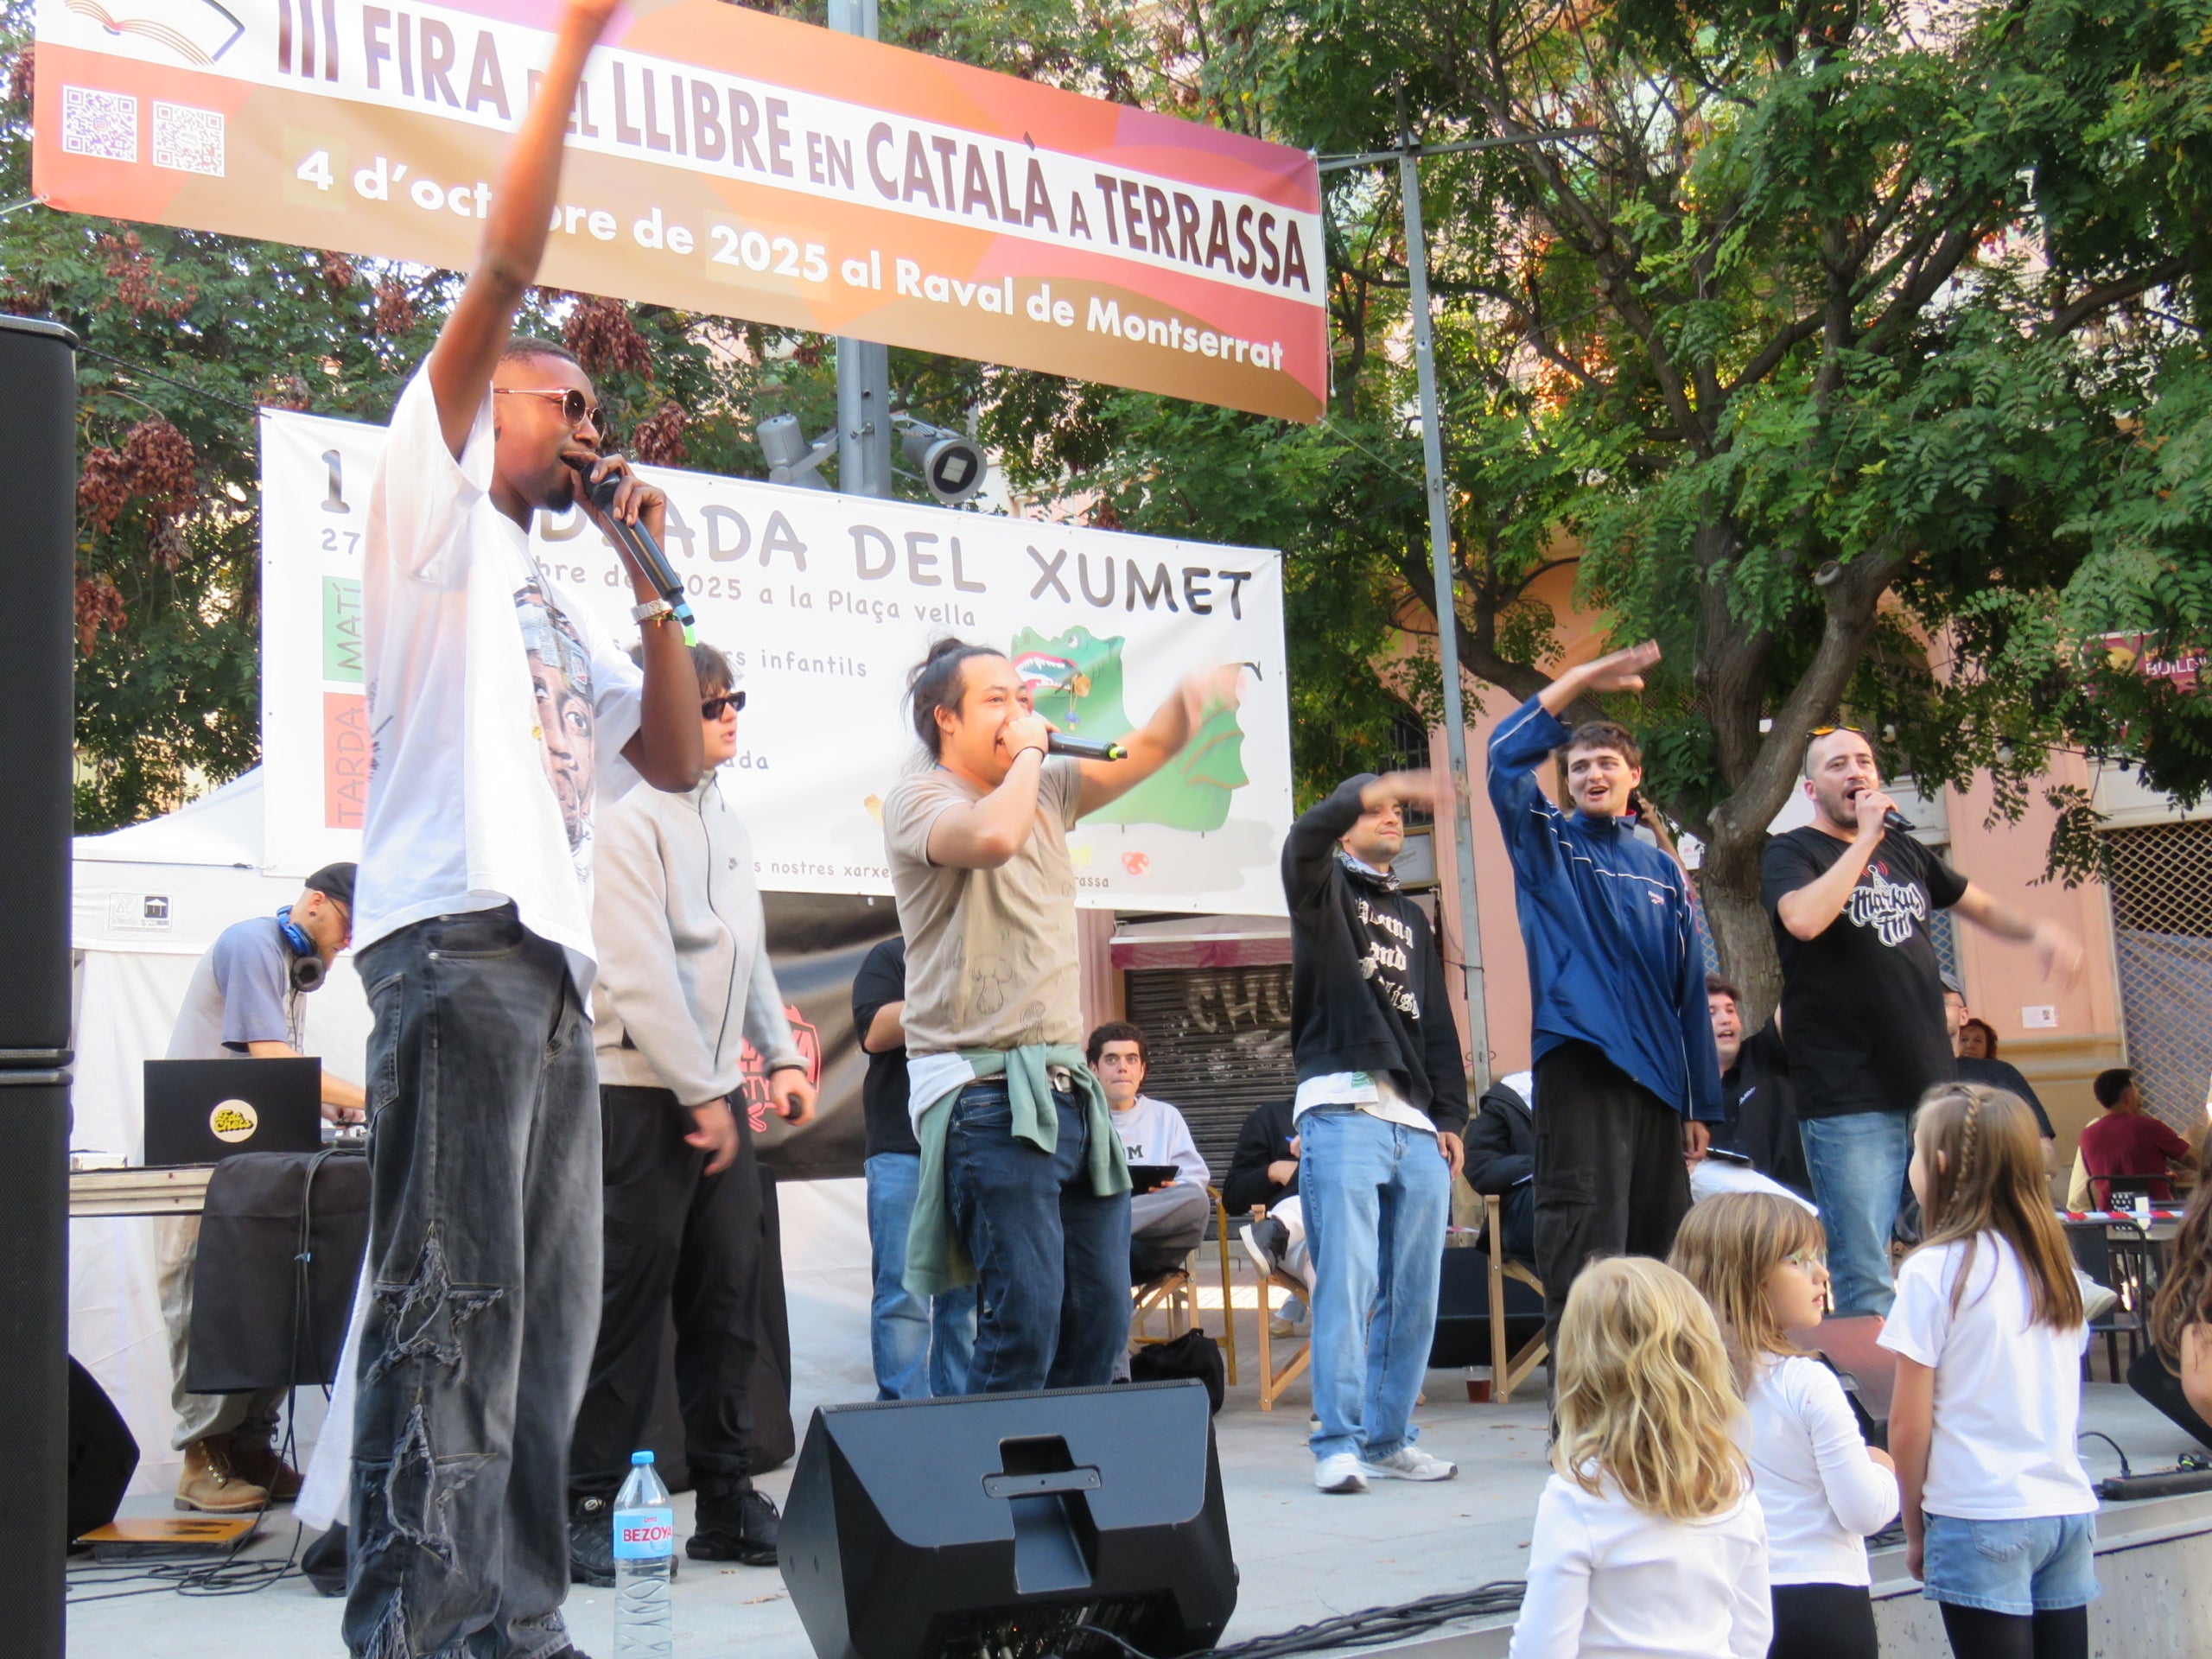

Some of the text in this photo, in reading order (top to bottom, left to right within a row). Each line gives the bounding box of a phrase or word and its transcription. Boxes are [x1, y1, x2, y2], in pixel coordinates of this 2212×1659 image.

[278, 0, 339, 82] III
[362, 4, 512, 121] FIRA
[613, 60, 793, 177] LLIBRE
[807, 130, 855, 192] EN
[867, 130, 1057, 234] CATALÀ
[1070, 191, 1093, 241] A
[1095, 173, 1311, 293] TERRASSA
[296, 150, 334, 191] 4
[633, 207, 694, 255] de
[709, 225, 829, 283] 2025
[842, 251, 881, 290] al
[896, 258, 1014, 316] Raval
[1027, 284, 1075, 329] de
[1087, 304, 1283, 372] Montserrat
[321, 528, 360, 556] 27
[676, 572, 741, 601] 025
[760, 588, 772, 605] a
[790, 585, 813, 610] la
[828, 589, 902, 626] Plaça
[914, 602, 976, 628] vella
[848, 524, 985, 594] DEL
[1027, 544, 1252, 621] XUMET
[336, 583, 362, 671] MATÍ
[761, 649, 868, 677] infantils
[335, 706, 365, 823] TARDA
[772, 861, 835, 876] nostres
[844, 864, 890, 879] xarxe
